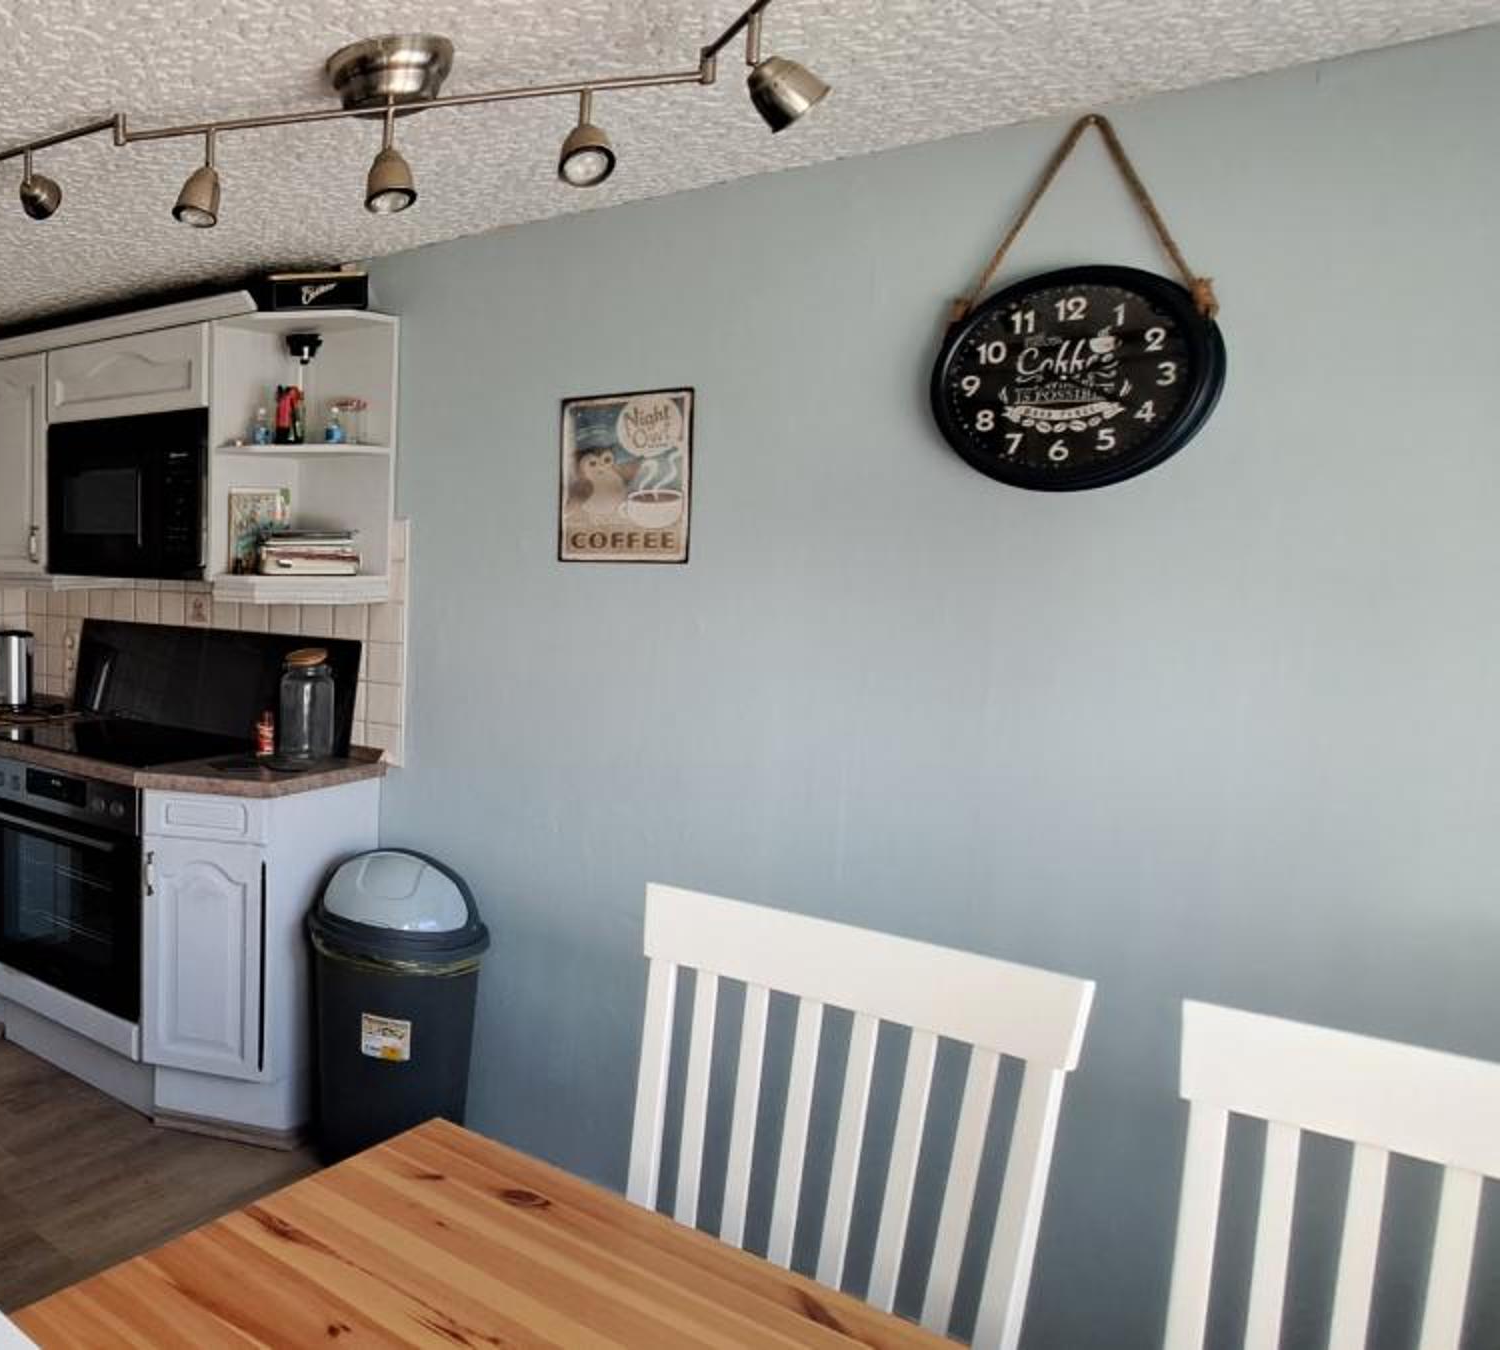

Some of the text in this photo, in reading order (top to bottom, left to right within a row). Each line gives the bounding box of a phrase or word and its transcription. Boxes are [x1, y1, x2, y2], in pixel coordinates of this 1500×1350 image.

[1055, 297, 1087, 321] 12
[1113, 302, 1126, 327] 1
[1010, 309, 1036, 335] 11
[1143, 326, 1167, 353] 2
[976, 340, 1007, 365] 10
[1155, 361, 1177, 386] 3
[960, 375, 981, 398] 9
[625, 405, 670, 431] Night
[974, 408, 995, 432] 8
[1134, 399, 1156, 423] 4
[1004, 432, 1023, 455] 7
[1047, 438, 1069, 462] 6
[1095, 427, 1116, 451] 5
[570, 531, 675, 550] COFFEE
